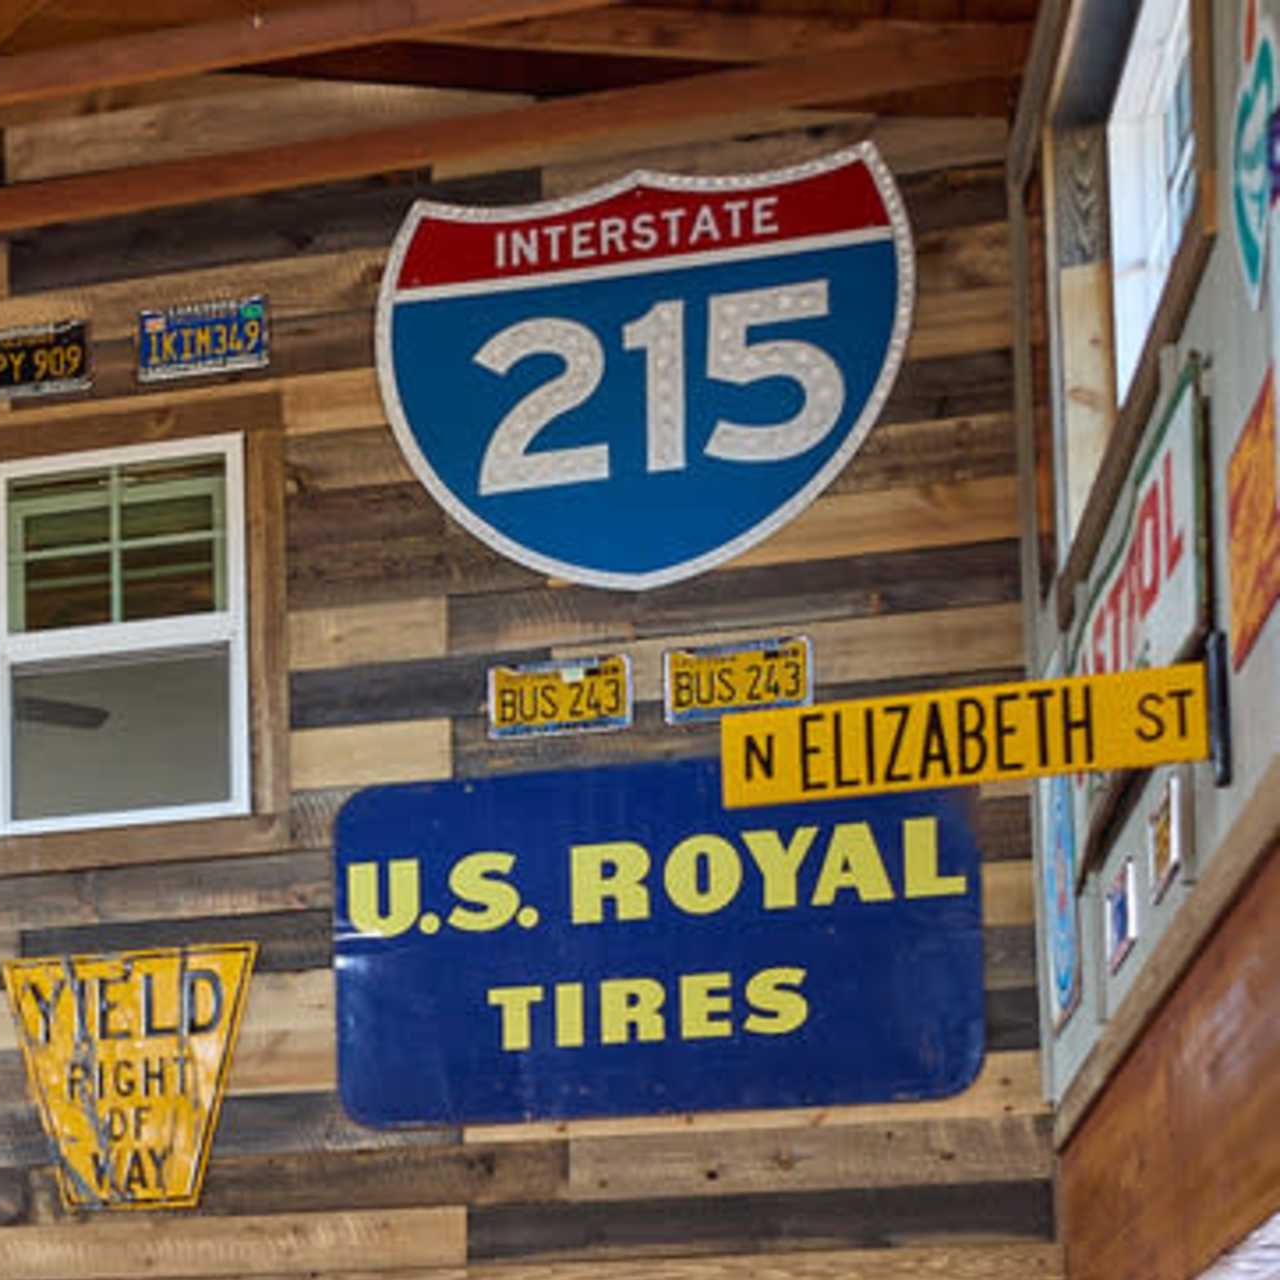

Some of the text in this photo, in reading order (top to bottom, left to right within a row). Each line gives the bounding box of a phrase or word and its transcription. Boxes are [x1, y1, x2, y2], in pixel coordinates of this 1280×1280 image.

[493, 197, 780, 270] INTERSTATE
[471, 277, 847, 498] 215
[499, 678, 621, 723] BUS 243
[673, 661, 802, 708] BUS 243
[742, 684, 1196, 794] N ELIZABETH ST
[345, 817, 969, 940] U.S. ROYAL
[21, 967, 226, 1045] YIELD
[486, 966, 810, 1053] TIRES
[67, 1053, 191, 1103] RIGHT
[106, 1107, 152, 1143] OF
[88, 1147, 174, 1198] WAY
